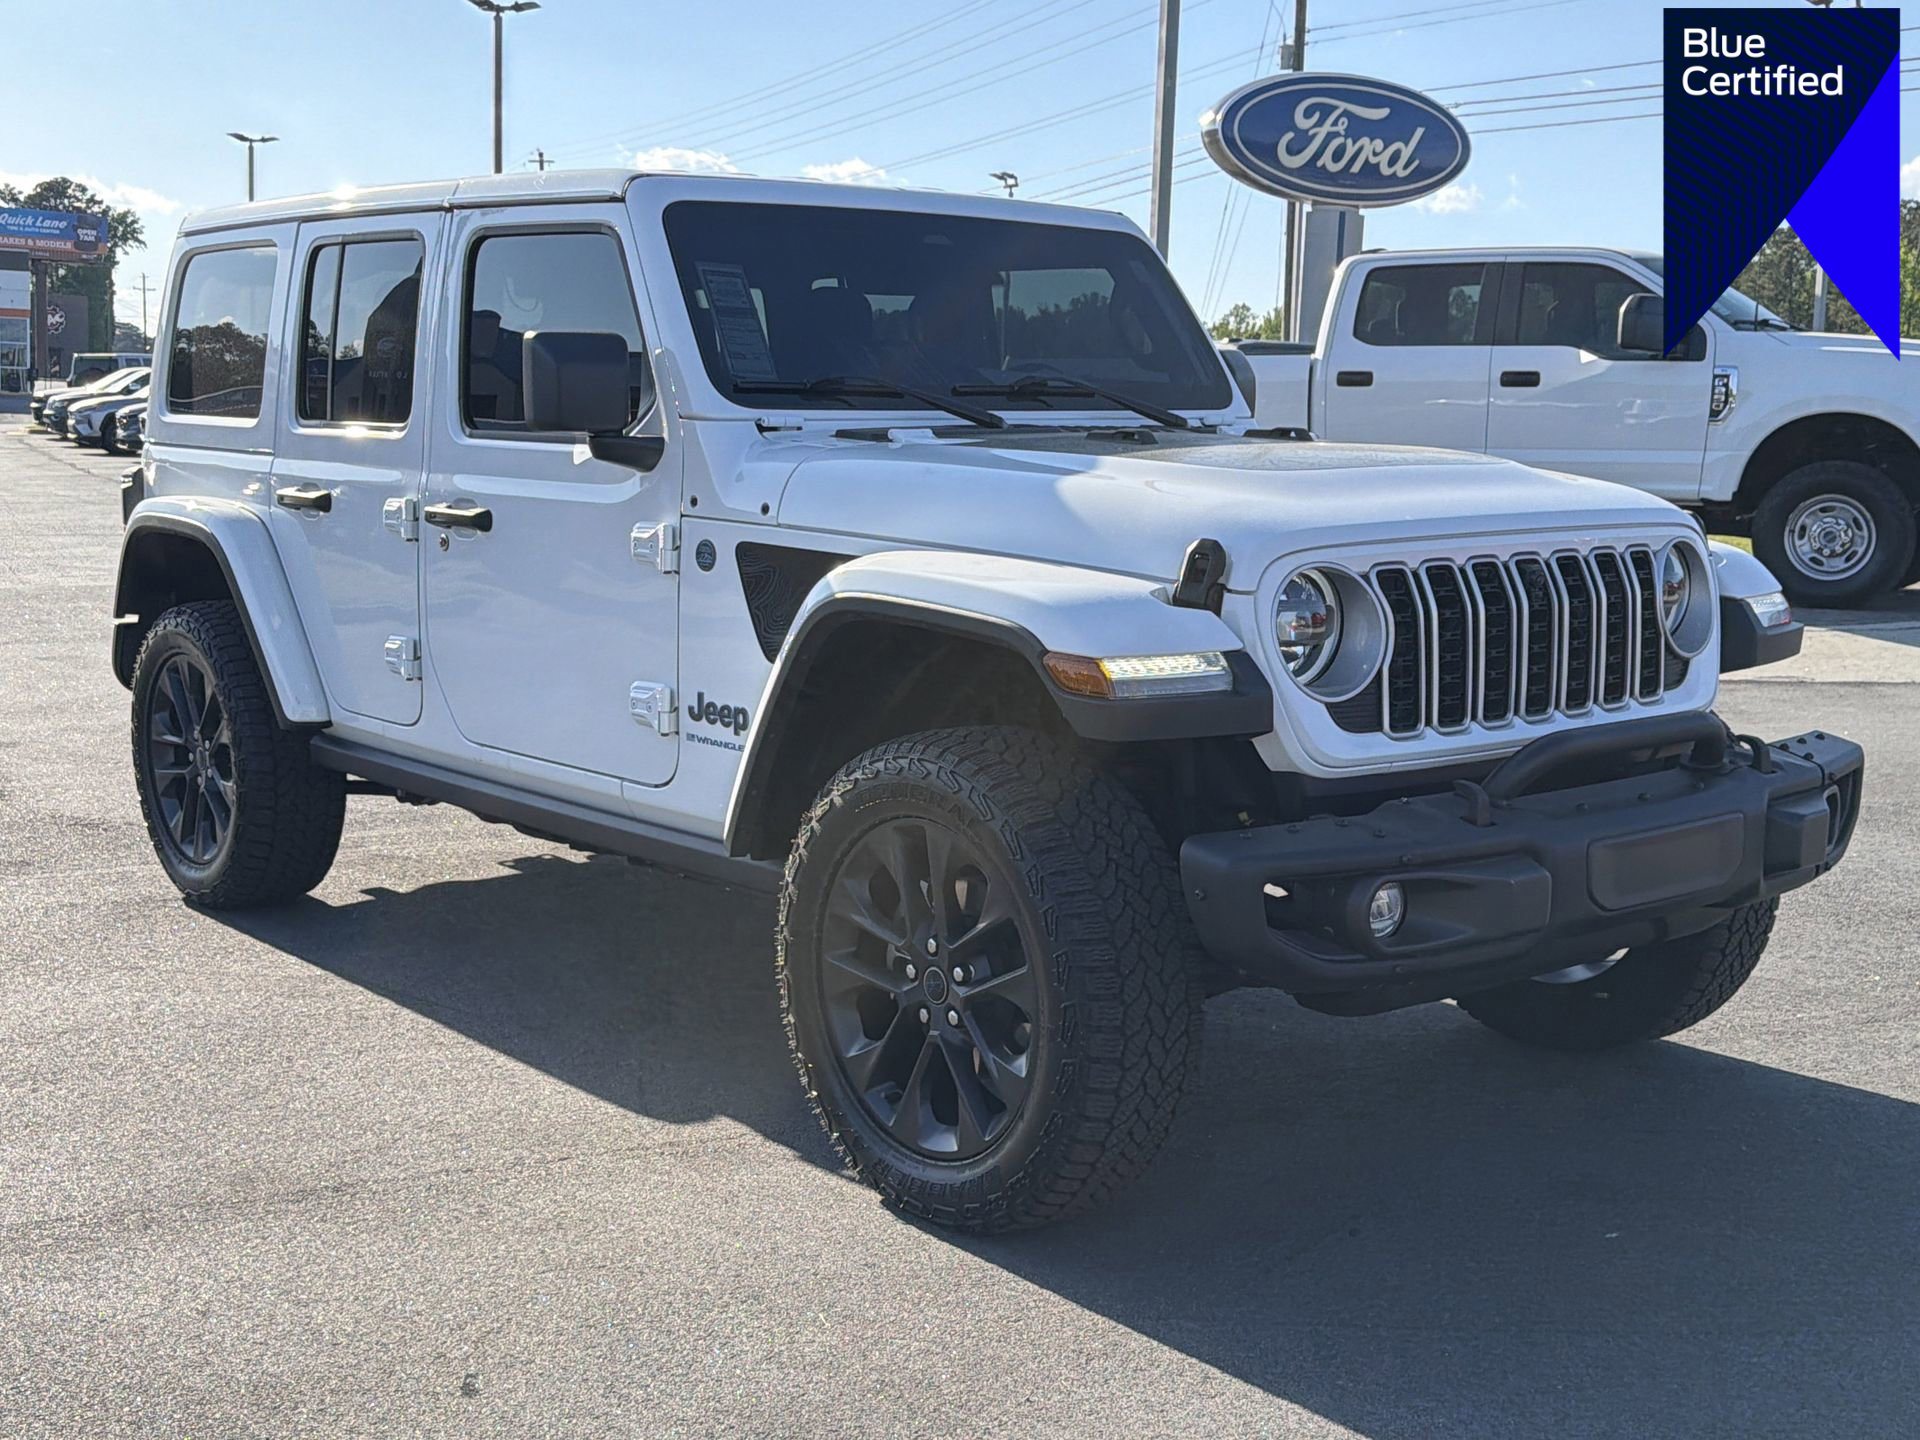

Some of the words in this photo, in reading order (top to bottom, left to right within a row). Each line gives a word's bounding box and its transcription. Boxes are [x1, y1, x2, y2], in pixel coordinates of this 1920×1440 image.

[1277, 96, 1426, 178] Ford
[0, 213, 35, 226] Quick
[35, 216, 68, 229] Lane
[77, 228, 97, 236] OPEN
[36, 239, 72, 249] MODELS
[688, 692, 750, 737] Jeep
